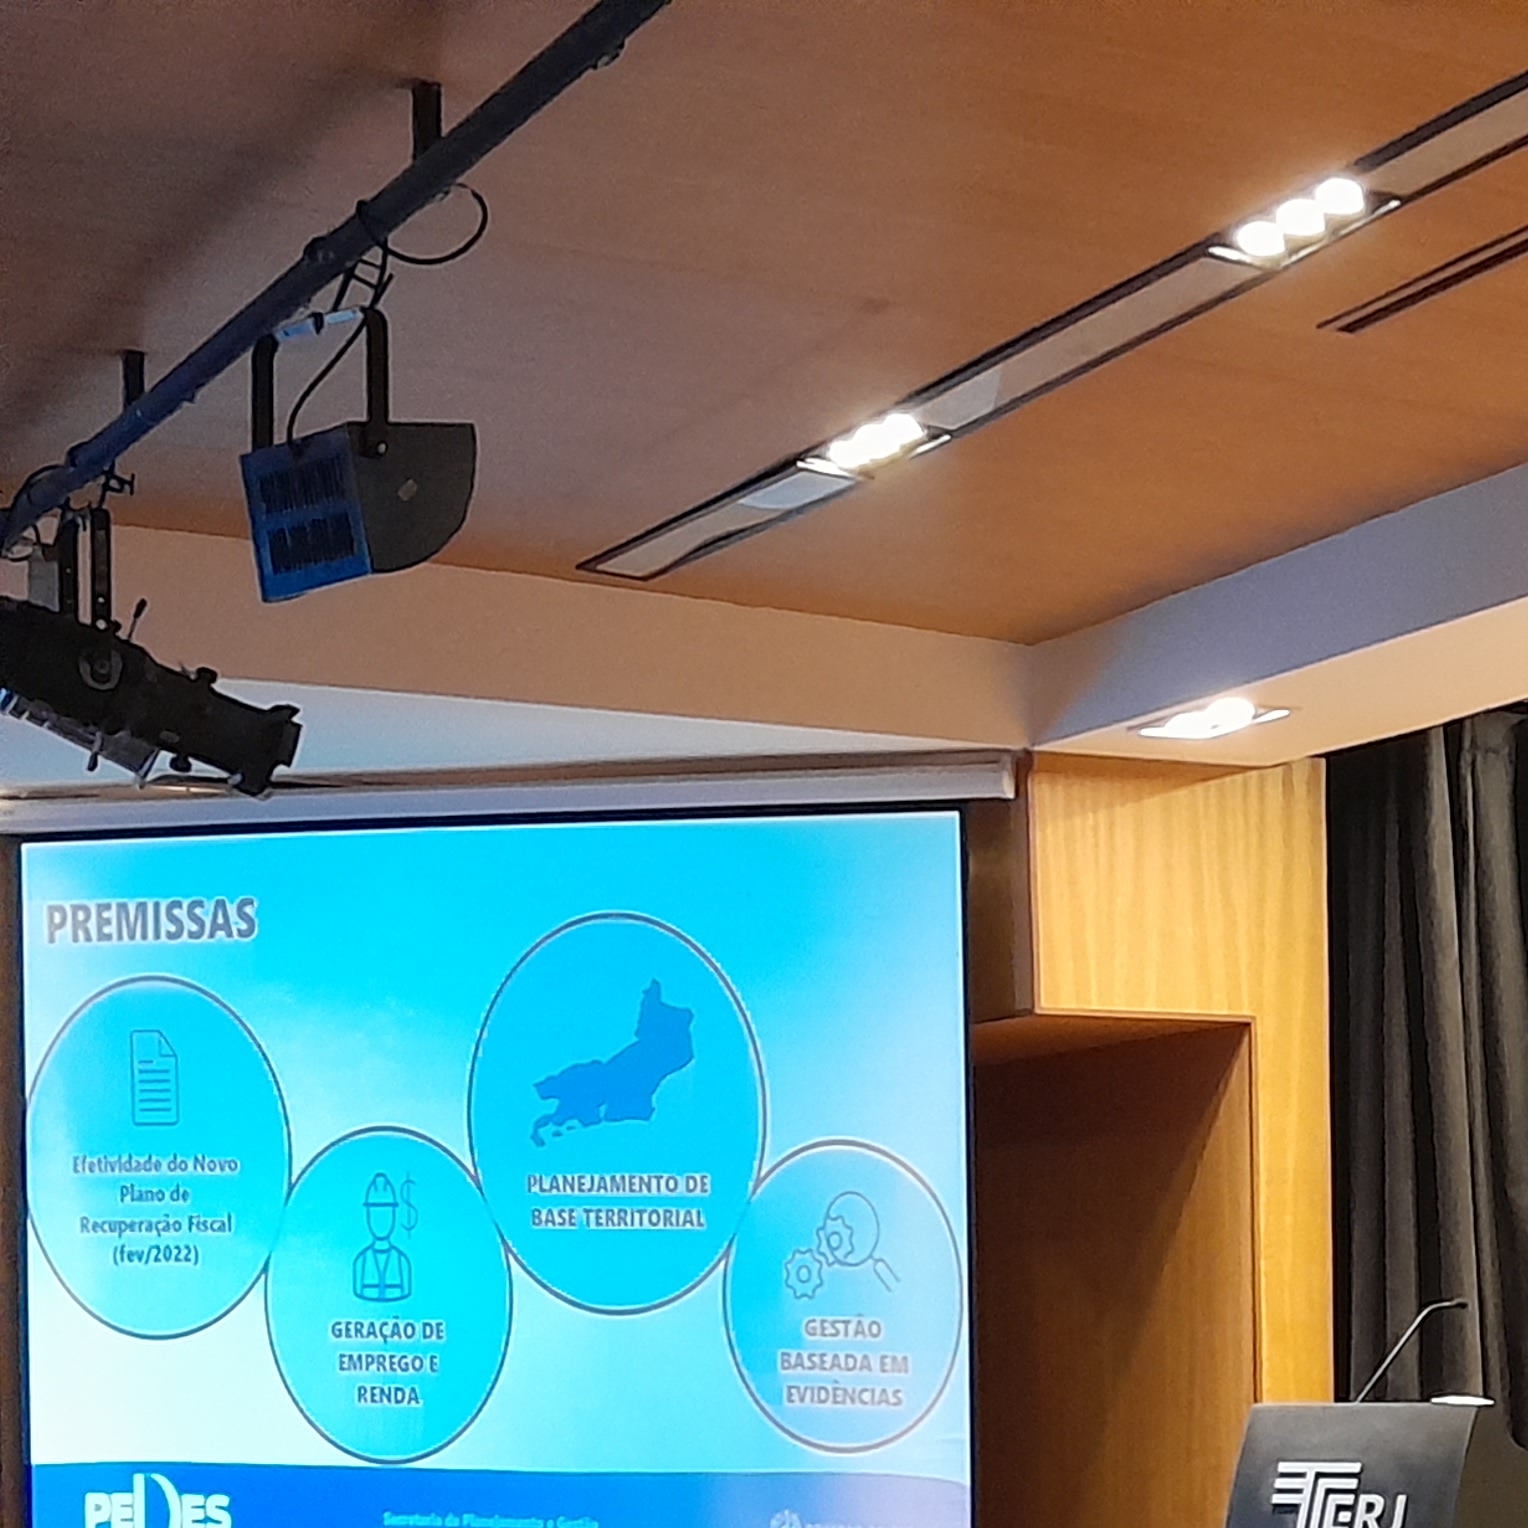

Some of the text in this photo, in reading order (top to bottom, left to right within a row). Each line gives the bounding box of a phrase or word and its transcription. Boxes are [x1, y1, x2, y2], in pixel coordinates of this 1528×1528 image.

[47, 898, 257, 944] PREMISSAS
[72, 1153, 239, 1174] Efetividade do Novo
[120, 1182, 190, 1203] Plano de
[527, 1174, 709, 1194] PLANEJAMENTO DE
[79, 1212, 232, 1238] Recuperação Fiscal
[531, 1208, 705, 1228] BASE TERRITORIAL
[113, 1243, 199, 1266] (fev/2022)
[331, 1315, 445, 1344] GERAÇÃO DE
[804, 1313, 882, 1338] GESTÃO
[338, 1354, 439, 1373] EMPREGO E
[780, 1351, 910, 1374] BASEADA EM
[357, 1385, 420, 1405] RENDA
[786, 1379, 903, 1407] EVIDÊNCIAS
